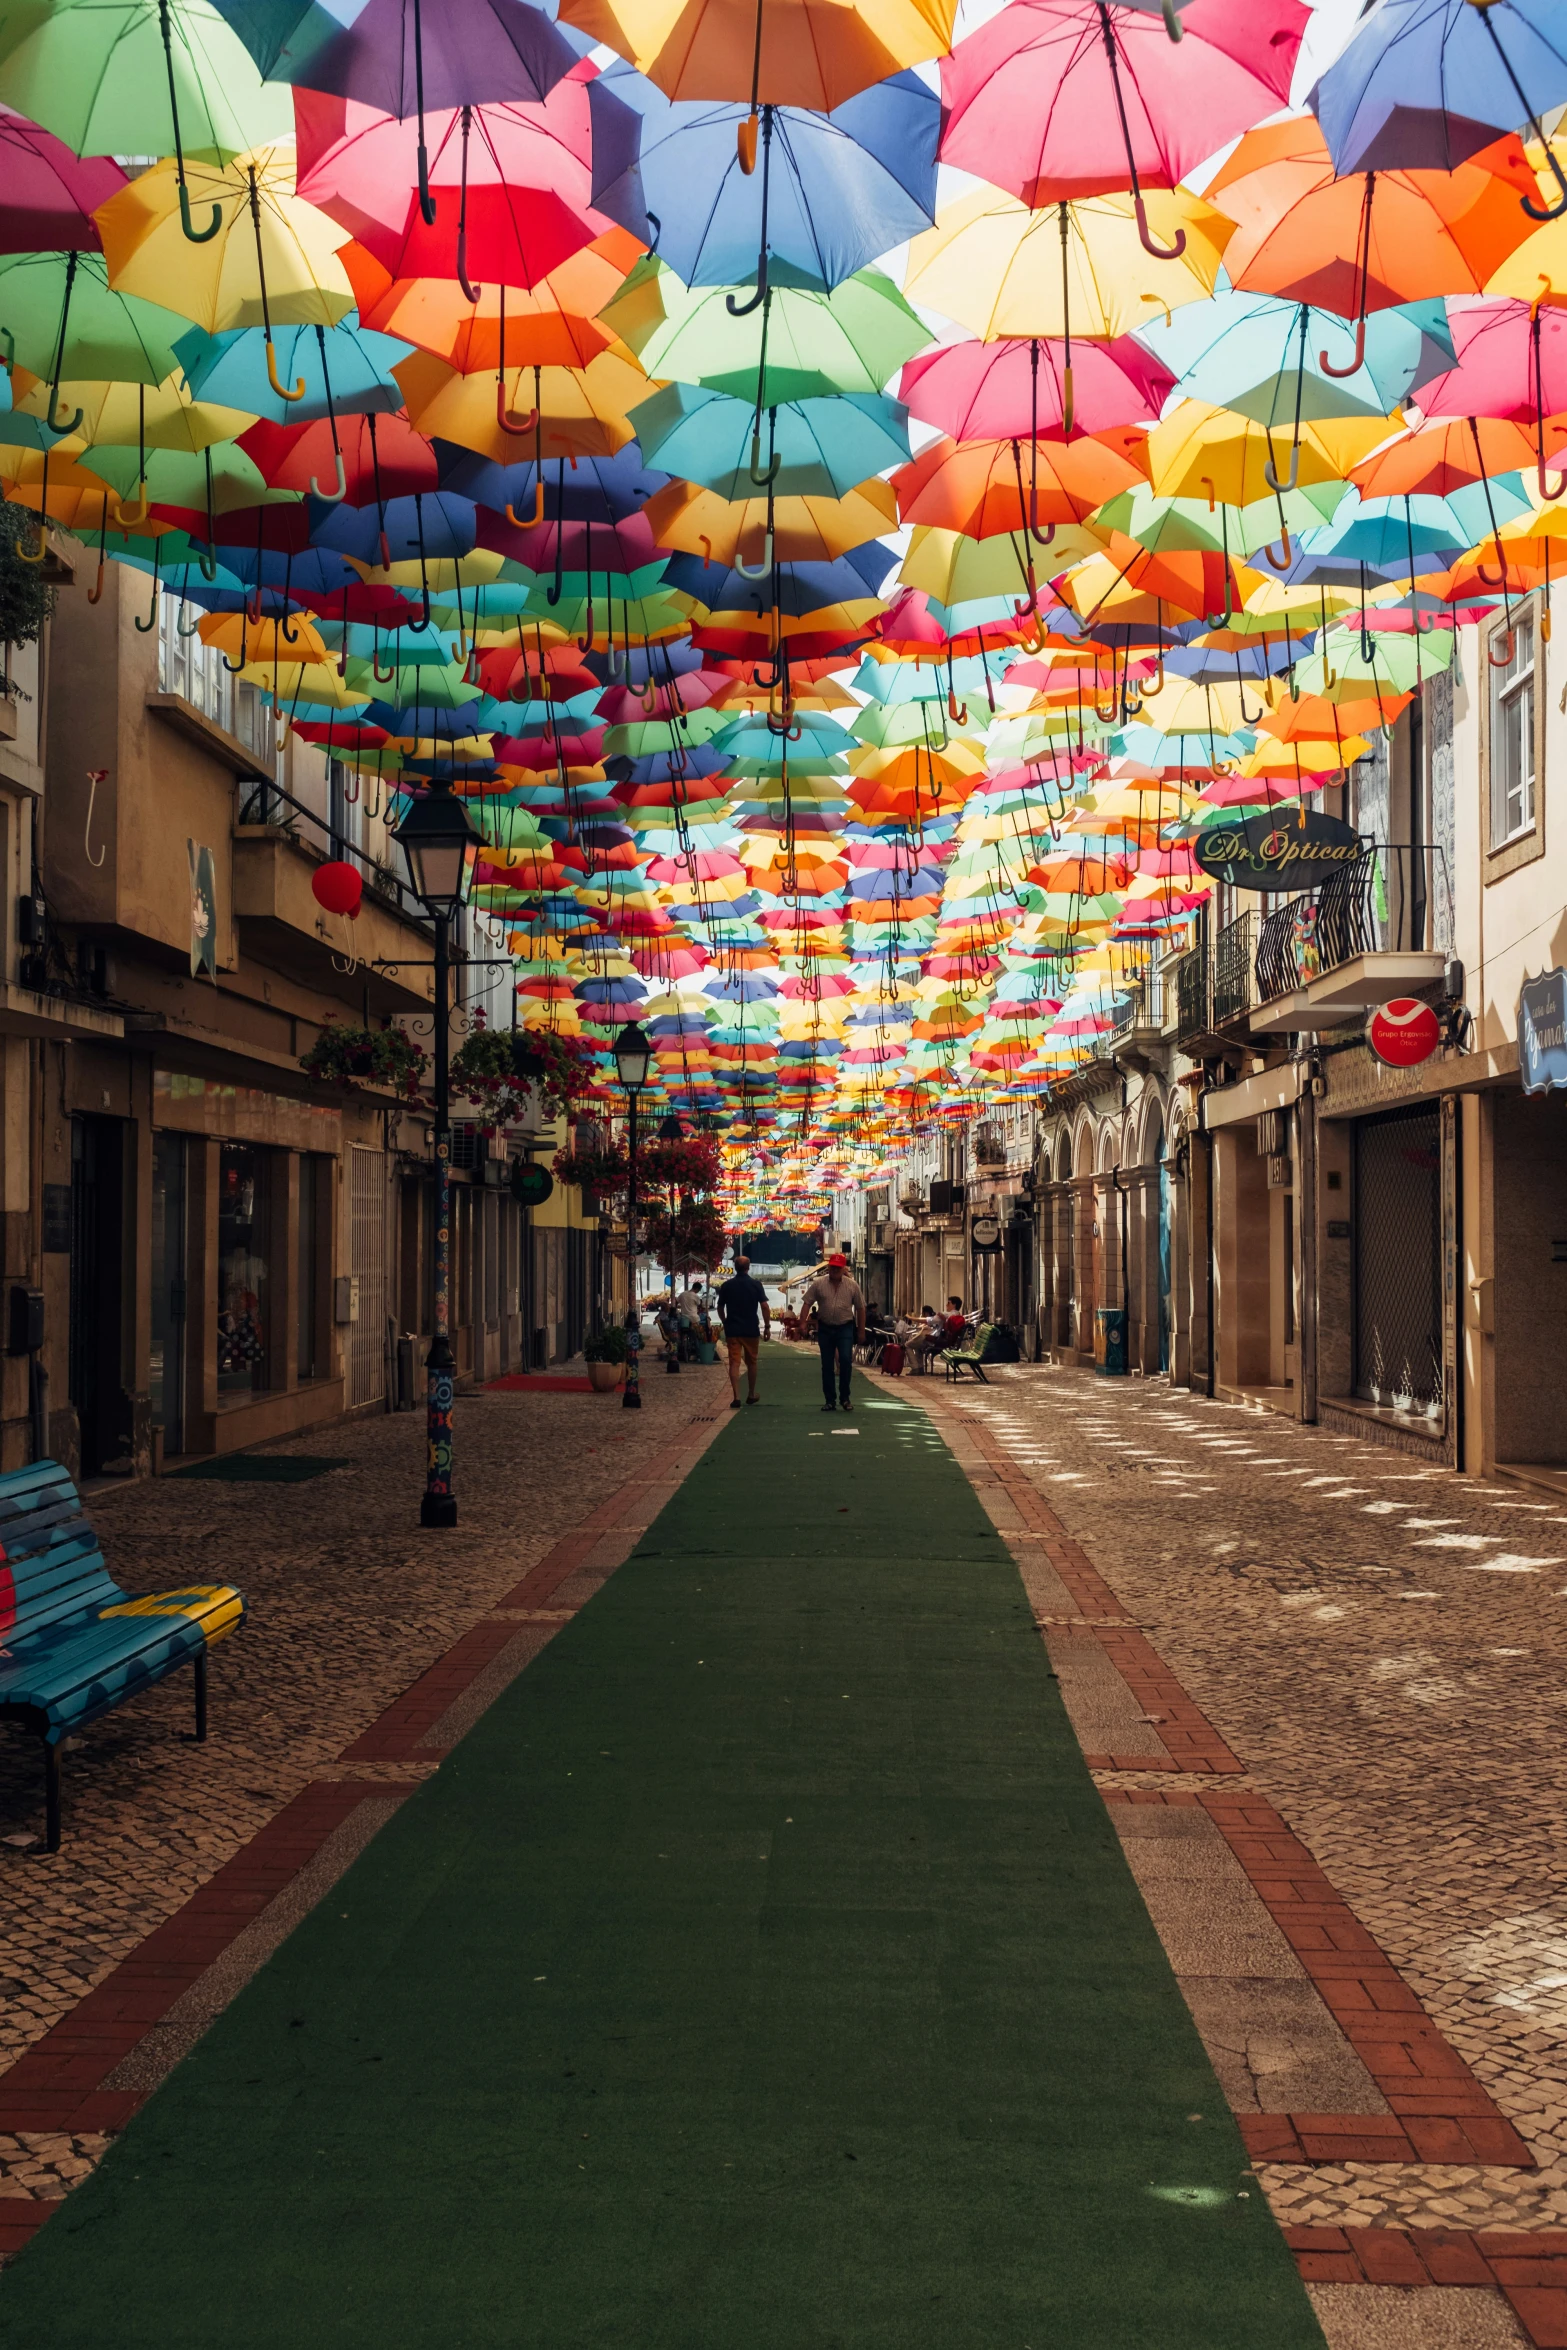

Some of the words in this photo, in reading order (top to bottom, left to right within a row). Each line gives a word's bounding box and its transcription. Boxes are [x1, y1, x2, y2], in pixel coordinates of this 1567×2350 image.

[1259, 823, 1359, 871] Ópticas
[1377, 1030, 1399, 1038] Grupo
[1257, 1111, 1276, 1156] RINO
